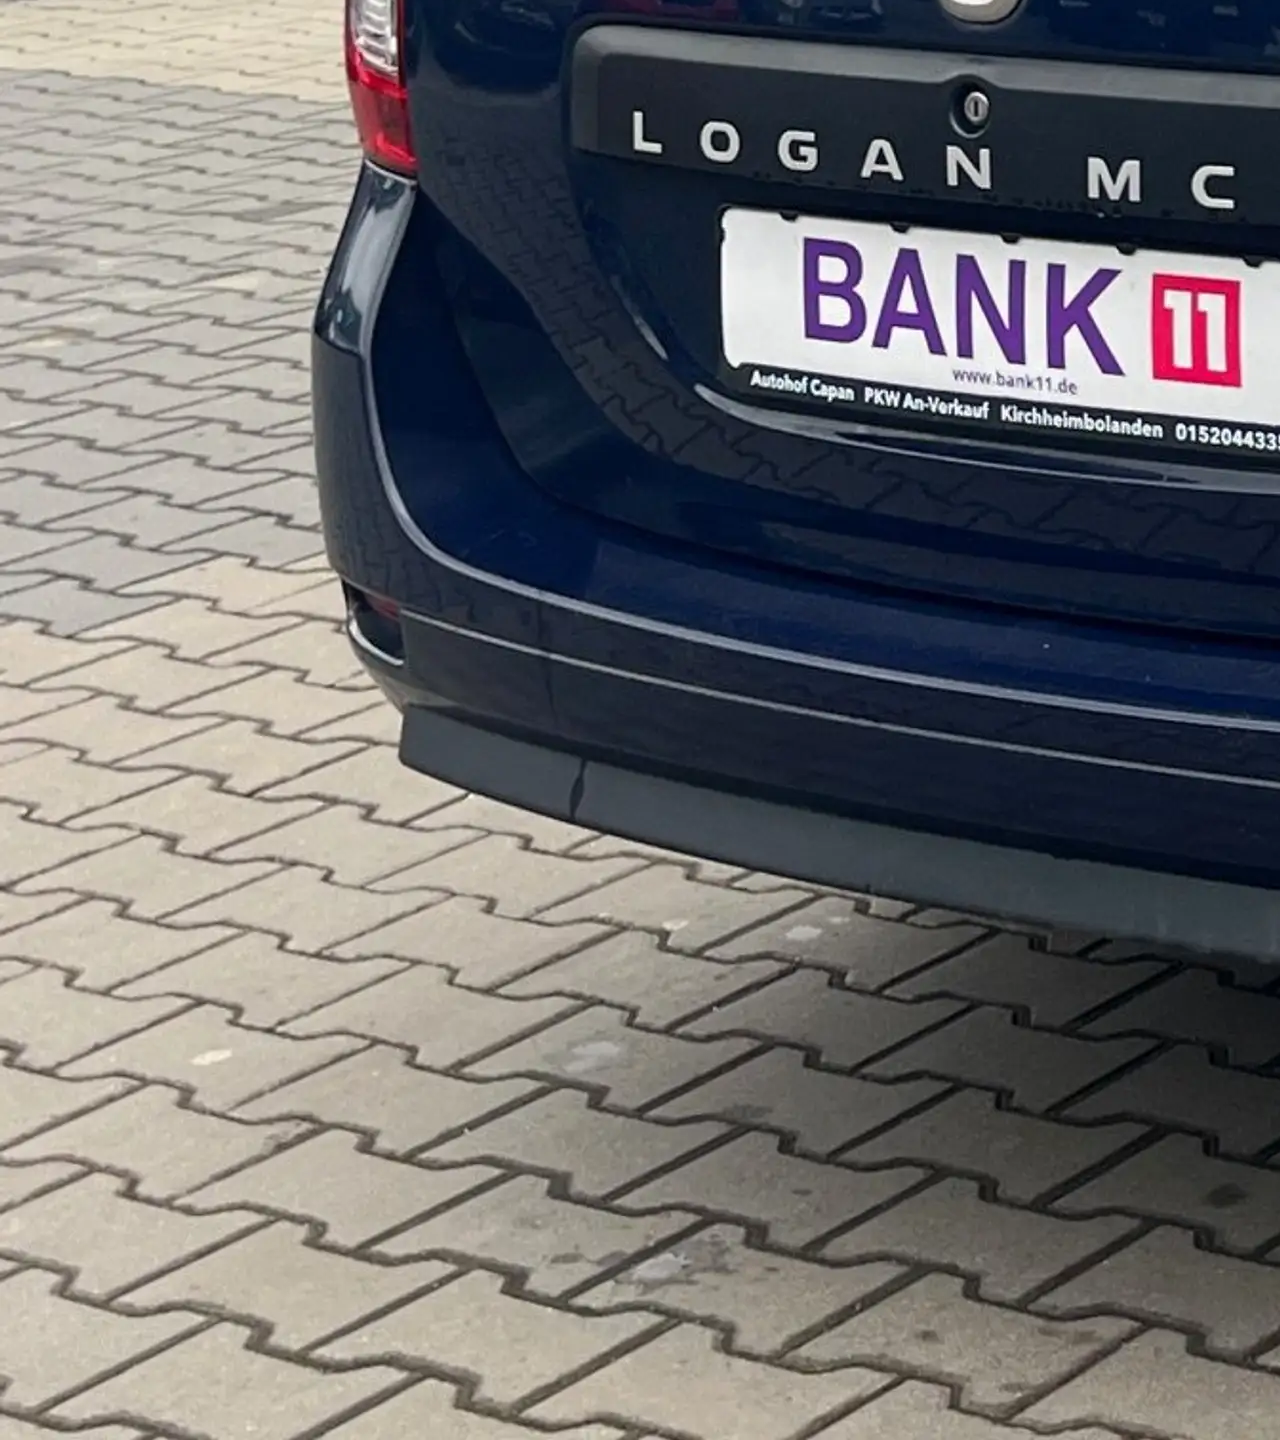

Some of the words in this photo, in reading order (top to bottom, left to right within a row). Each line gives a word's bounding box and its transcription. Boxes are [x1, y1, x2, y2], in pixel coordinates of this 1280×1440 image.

[632, 110, 992, 190] LOGAN
[803, 236, 1126, 377] BANK
[1160, 285, 1230, 376] 11
[750, 369, 808, 394] Autohof
[810, 378, 855, 402] Capan
[864, 386, 900, 408] PKW
[902, 389, 990, 421] An-Verkauf
[1001, 404, 1164, 439] Kirchheimbolanden
[952, 367, 1079, 395] www.bank11.de
